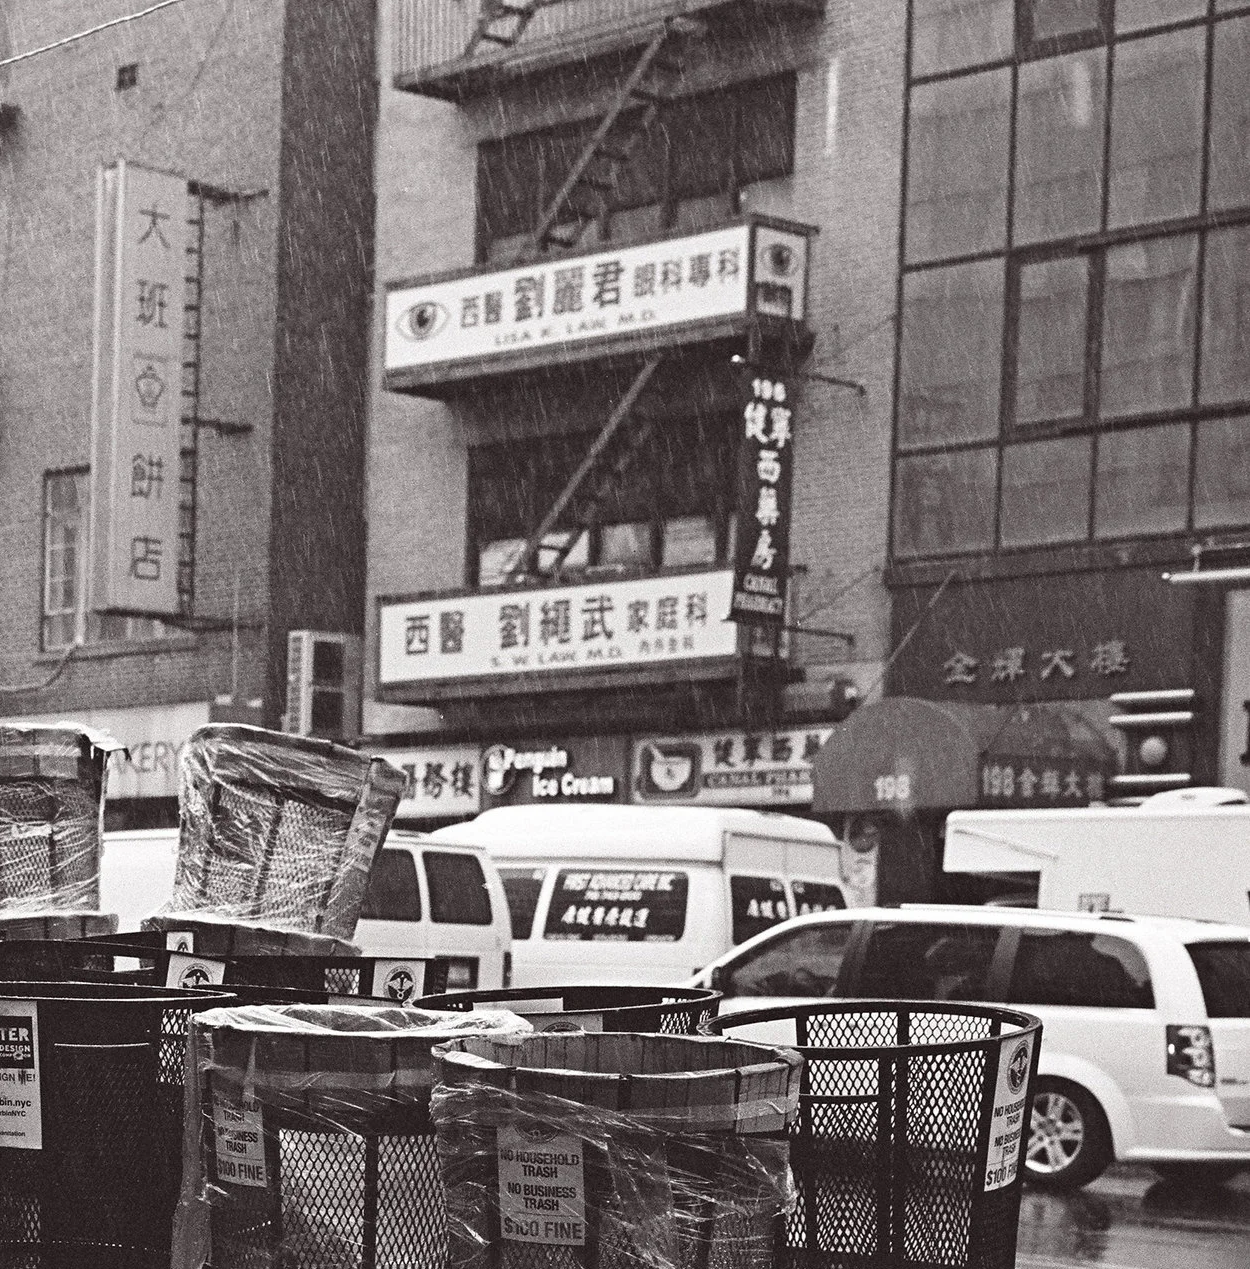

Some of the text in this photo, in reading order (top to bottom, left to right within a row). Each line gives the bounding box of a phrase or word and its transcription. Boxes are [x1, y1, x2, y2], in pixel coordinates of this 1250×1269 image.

[495, 331, 531, 346] LISA
[116, 741, 186, 776] KERY
[532, 772, 614, 797] Ice Cream
[0, 1045, 31, 1053] DESIGN
[994, 1106, 1004, 1117] NO
[226, 1140, 246, 1153] TRASH
[994, 1135, 1004, 1147] NO
[501, 1150, 580, 1166] NO HOUSEHOLD
[239, 1163, 263, 1180] FINE
[522, 1165, 558, 1179] TRASH
[986, 1167, 1007, 1186] $100
[507, 1182, 577, 1199] NO BUSINESS
[523, 1197, 559, 1211] TRASH
[544, 1221, 582, 1240] FINE
